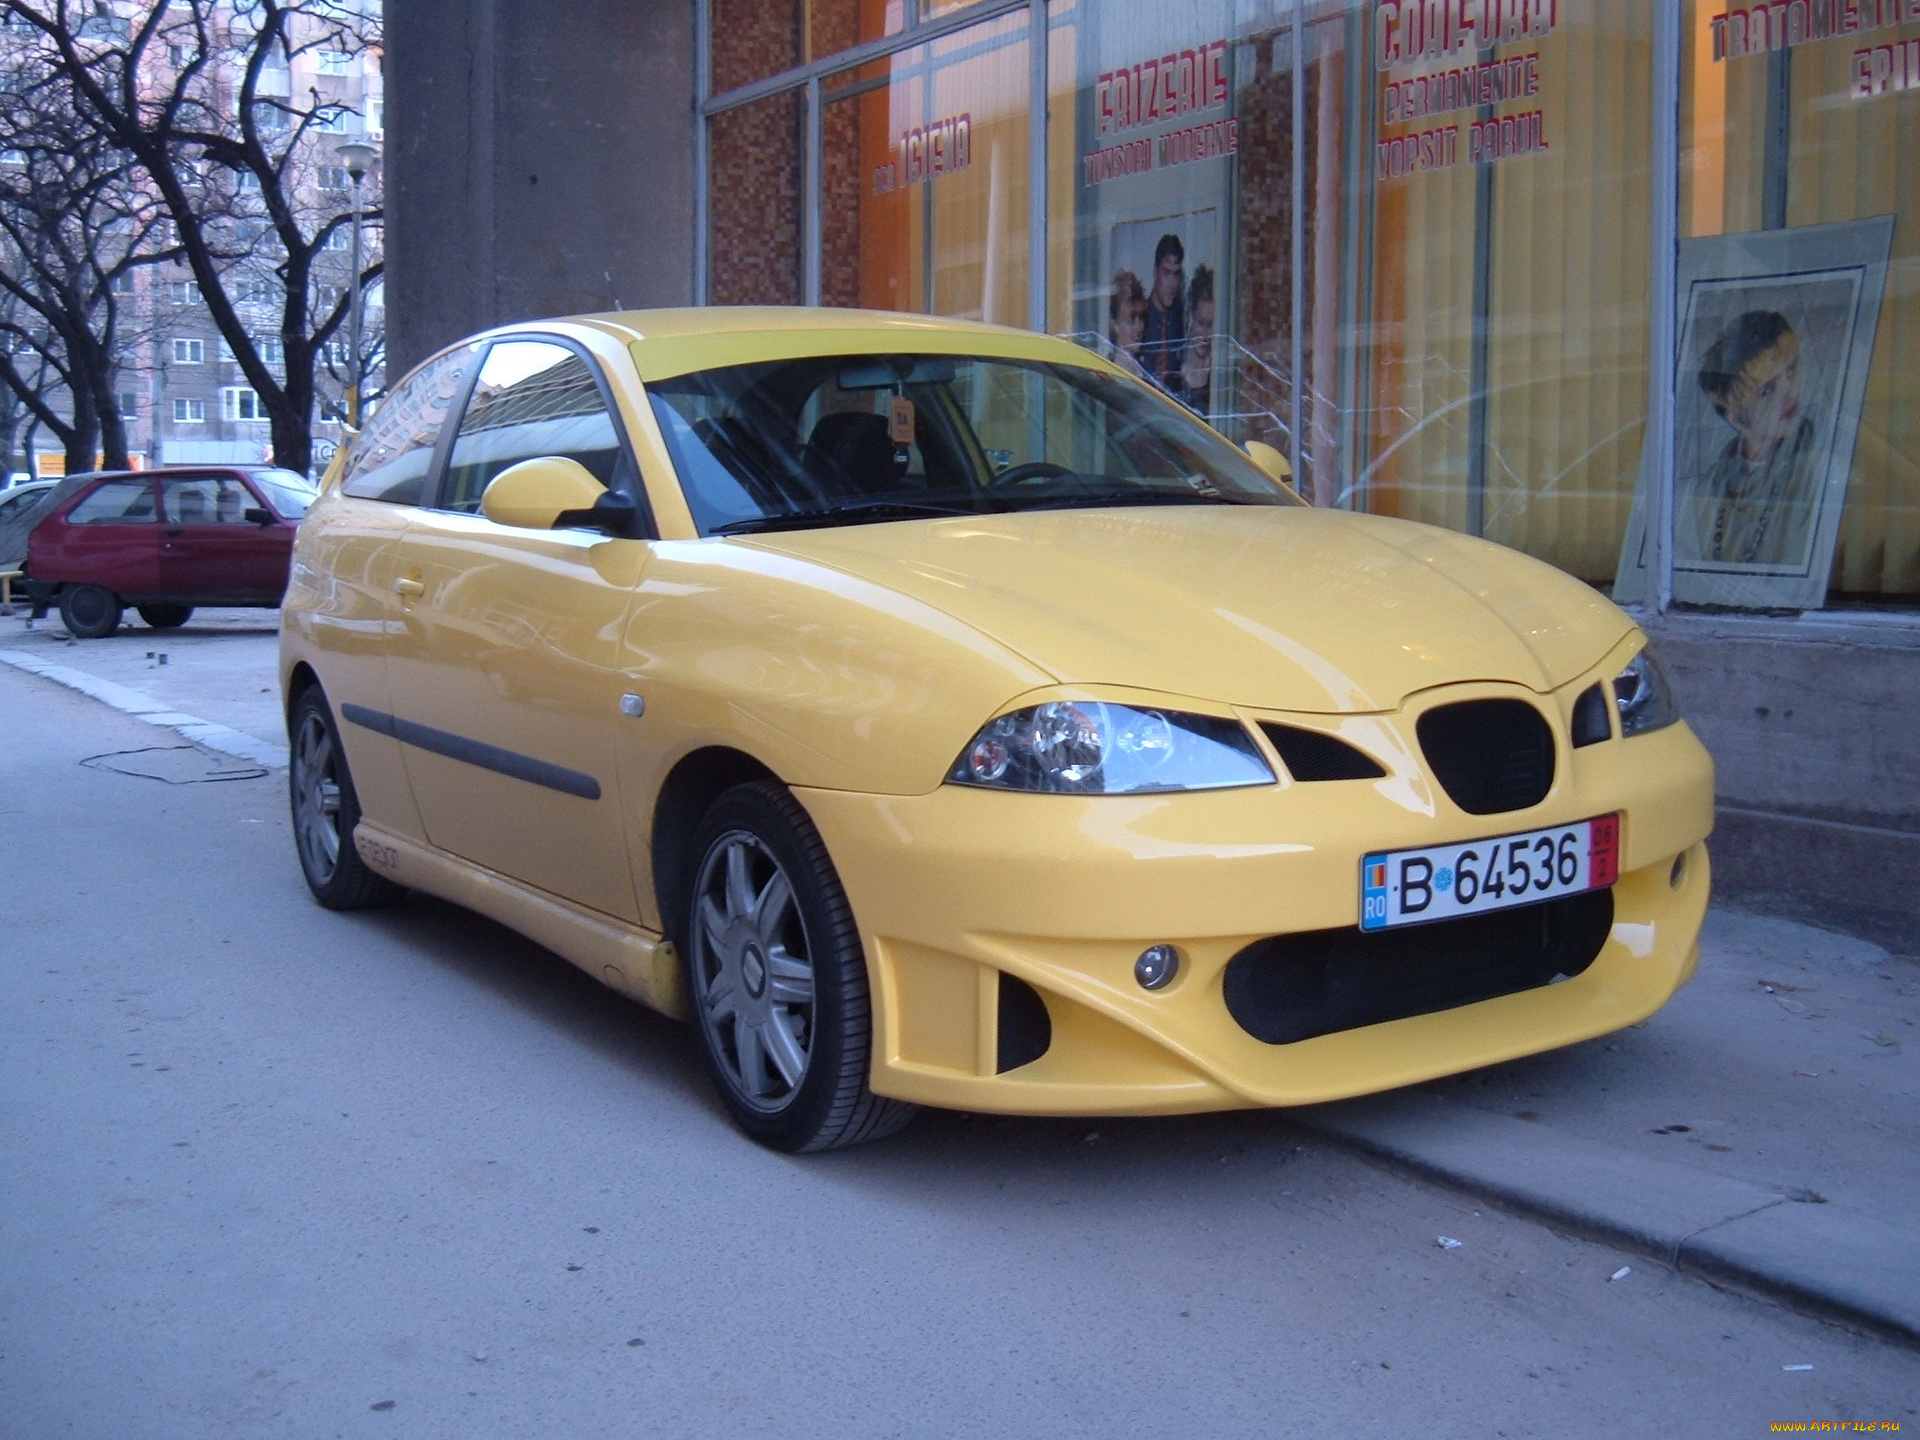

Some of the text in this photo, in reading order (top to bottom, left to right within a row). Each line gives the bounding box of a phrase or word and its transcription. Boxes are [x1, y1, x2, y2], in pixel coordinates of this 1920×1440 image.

[1094, 39, 1228, 140] FRIZERIE
[1384, 51, 1540, 125] PERMANENTE
[900, 112, 971, 188] IGIENA
[1084, 116, 1239, 187] TUNSORI MODERNE
[1377, 109, 1549, 181] VOPSIT PARUL
[1365, 896, 1385, 919] RO
[1399, 832, 1578, 915] B 64536
